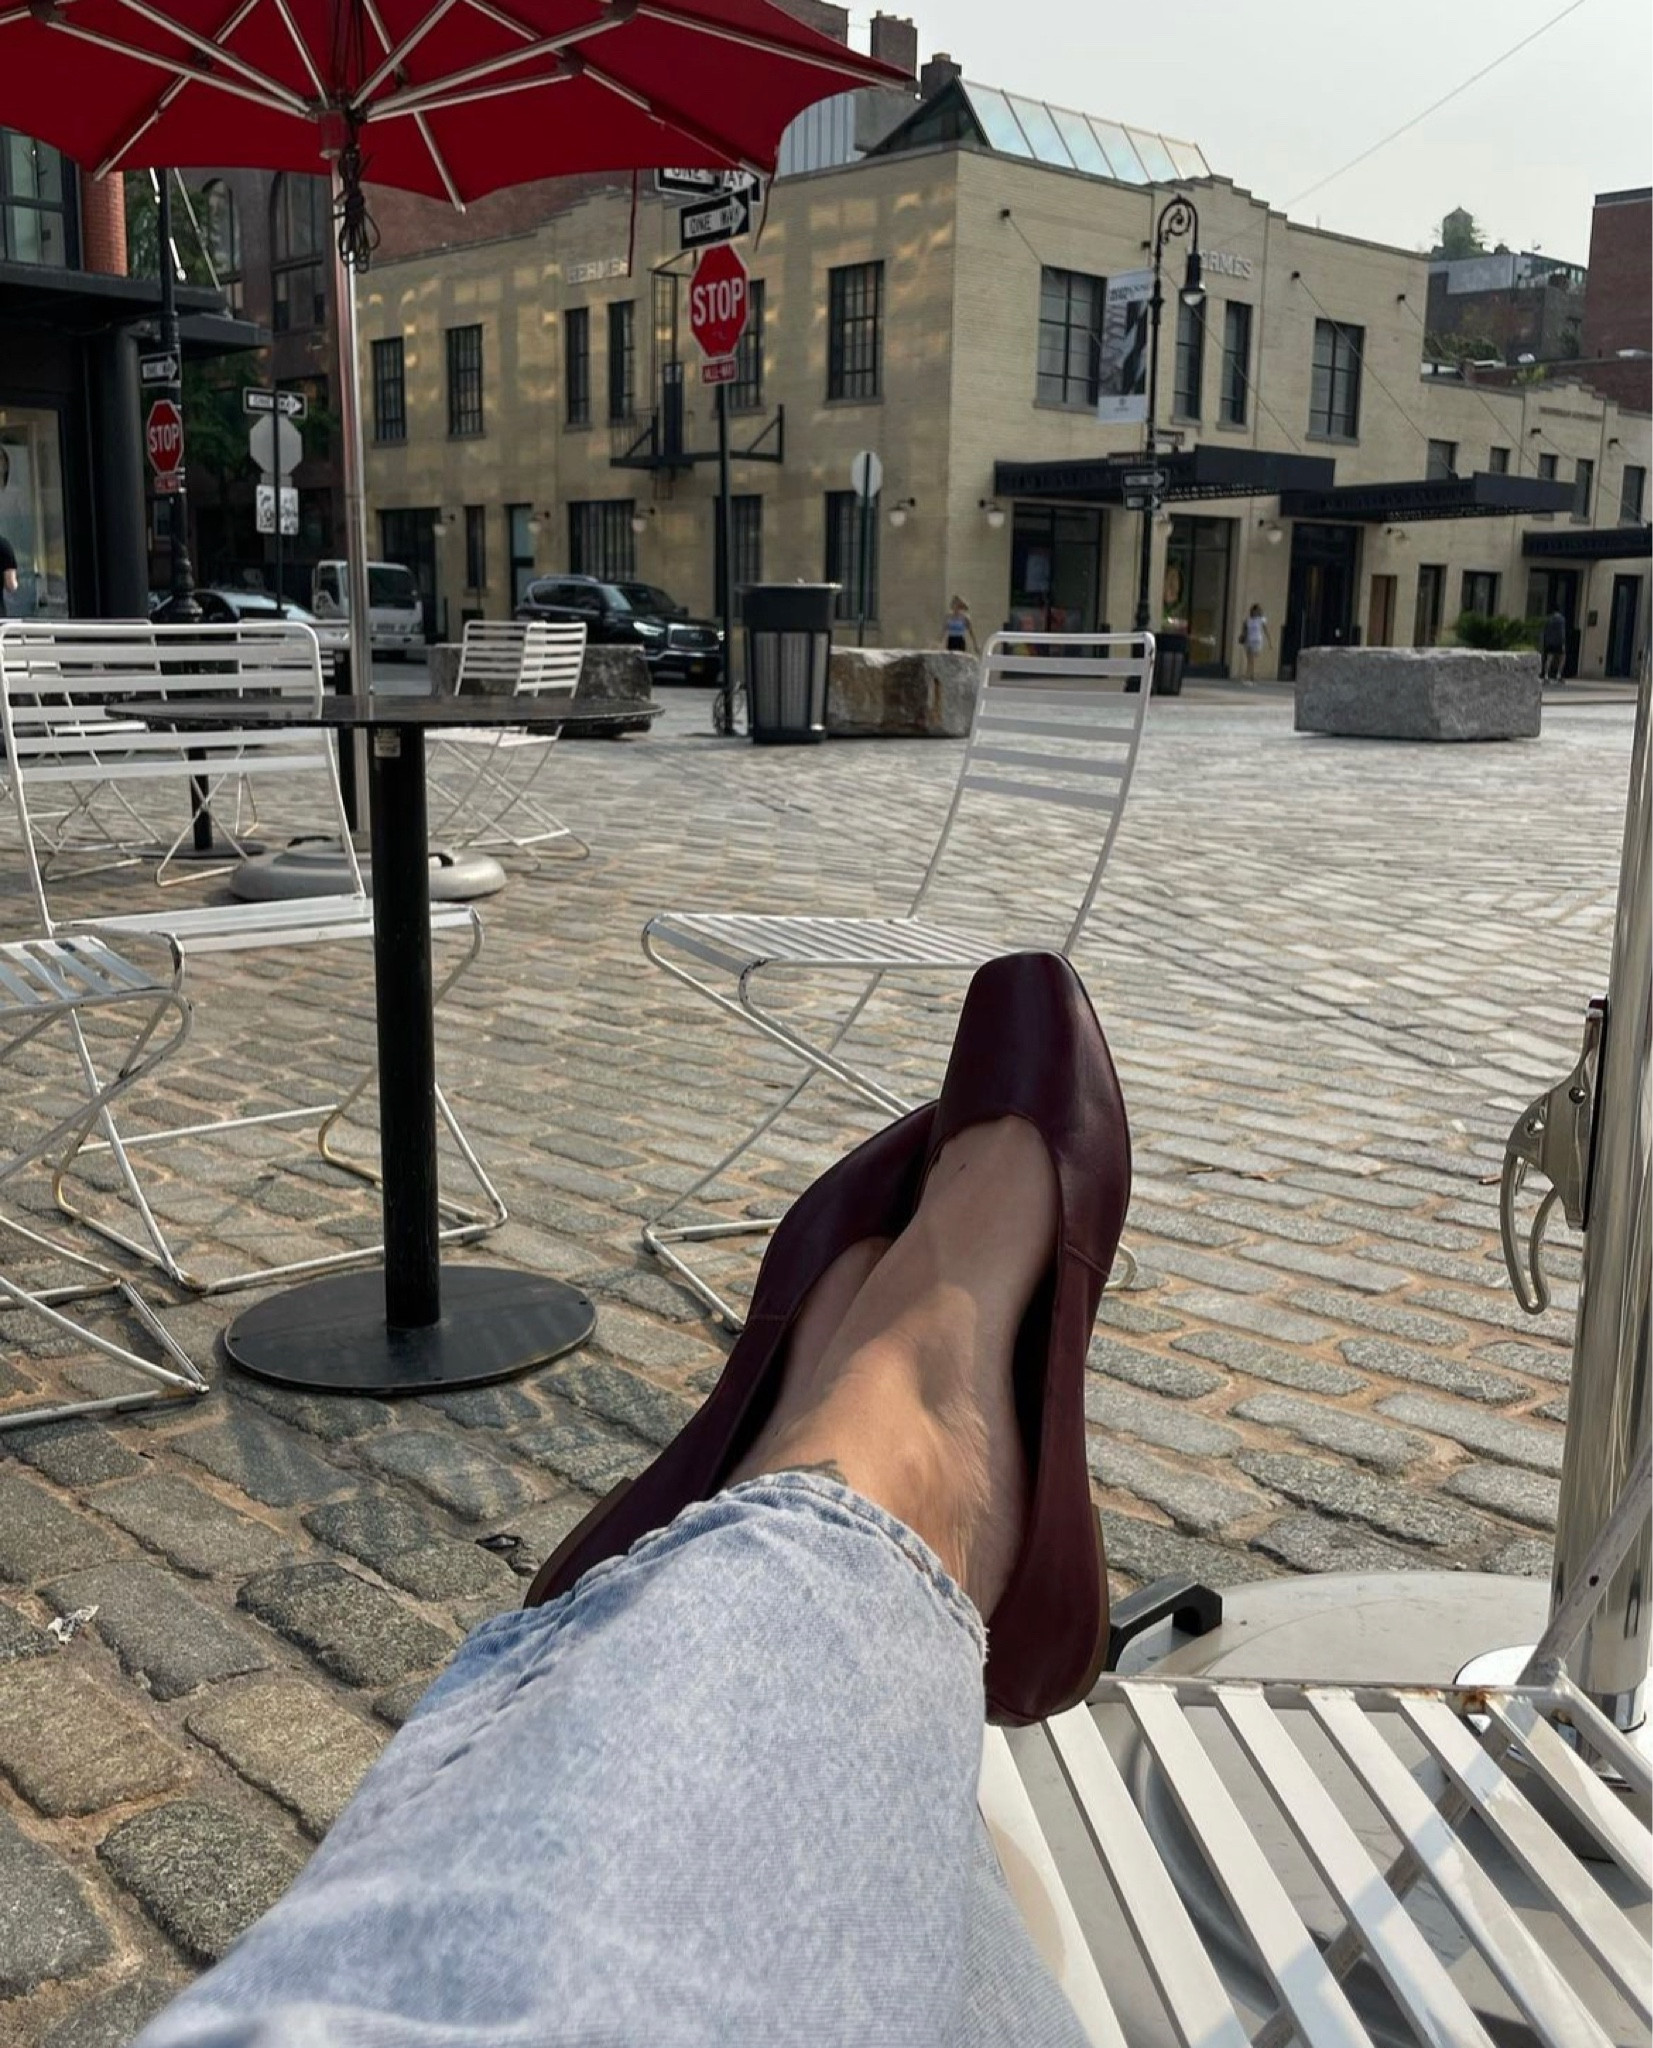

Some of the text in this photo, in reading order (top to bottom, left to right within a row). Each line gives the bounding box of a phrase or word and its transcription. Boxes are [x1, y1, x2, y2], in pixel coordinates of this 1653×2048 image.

[689, 206, 740, 235] ONE WAY
[1199, 250, 1251, 279] ERMÈS
[693, 278, 744, 327] STOP
[150, 424, 179, 453] STOP
